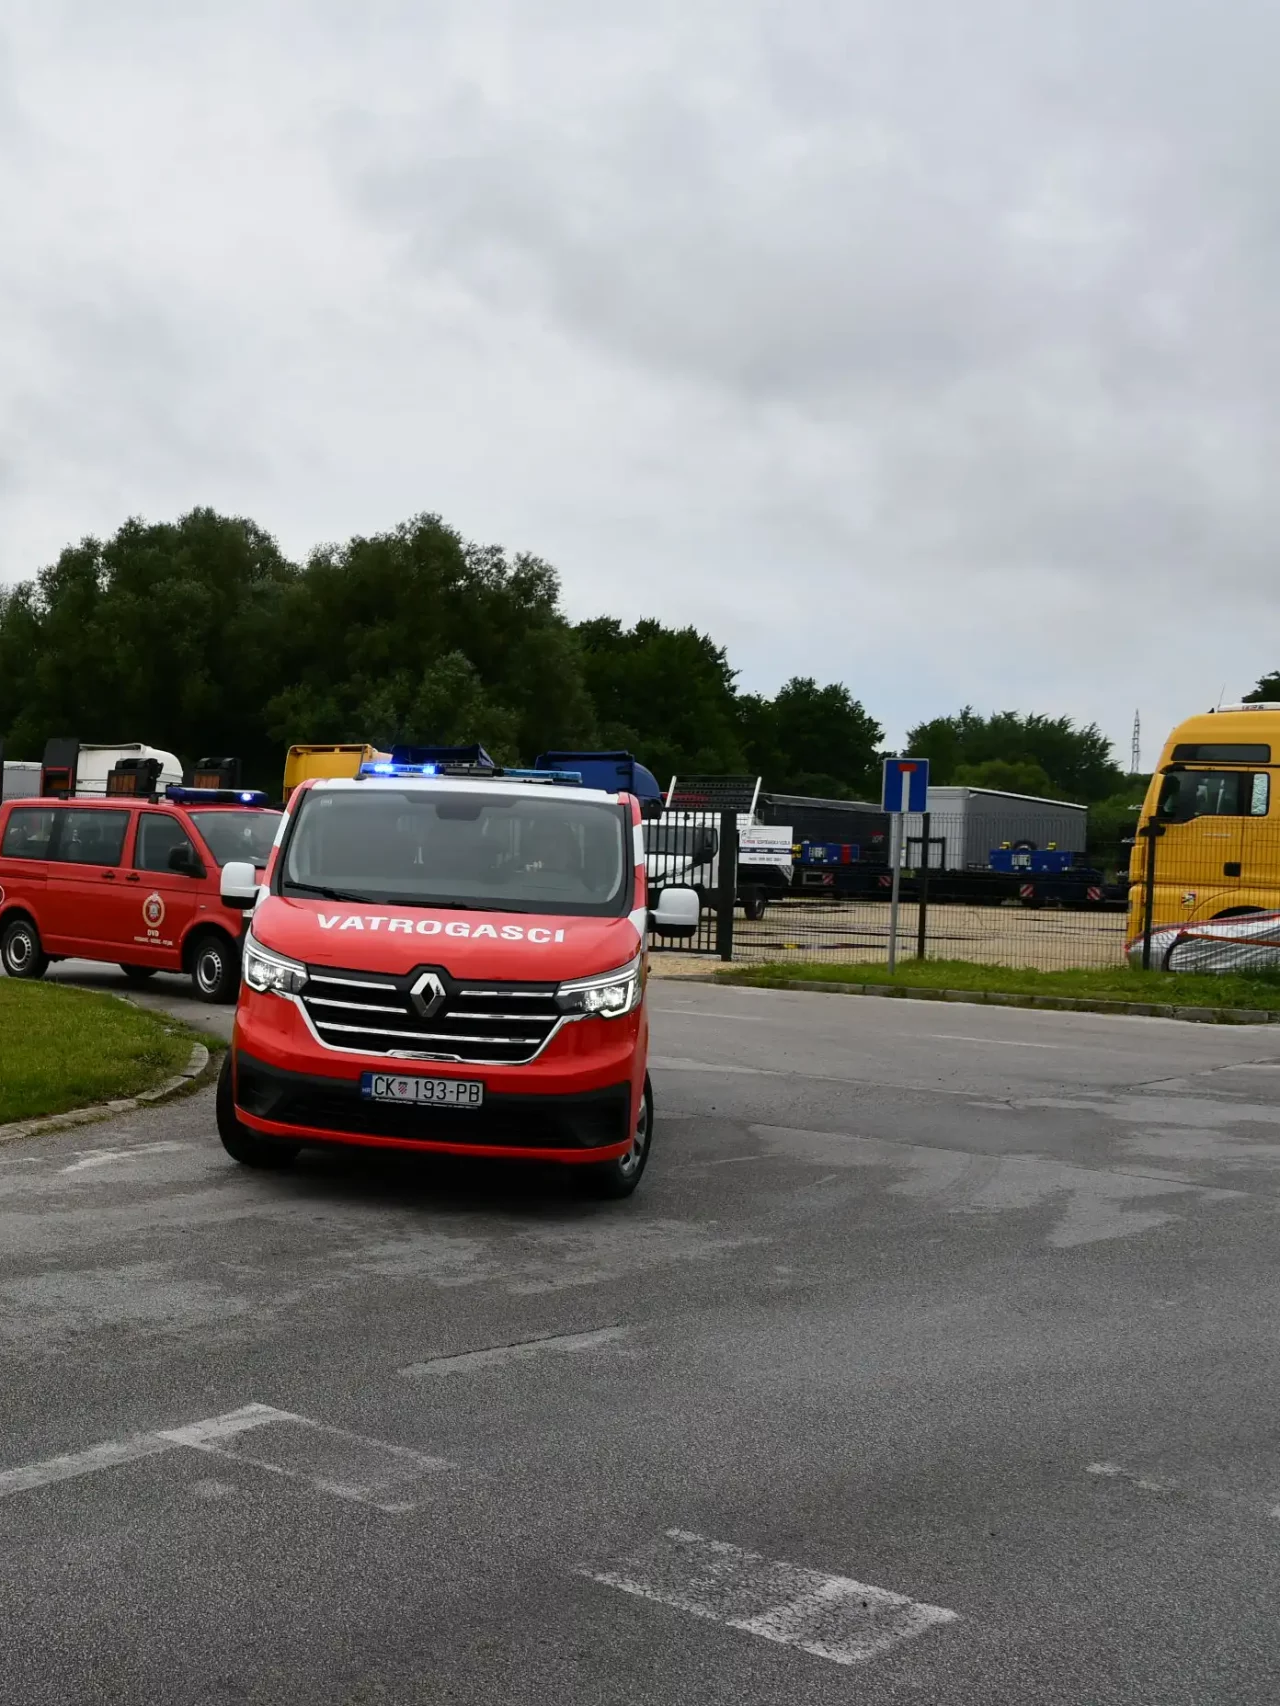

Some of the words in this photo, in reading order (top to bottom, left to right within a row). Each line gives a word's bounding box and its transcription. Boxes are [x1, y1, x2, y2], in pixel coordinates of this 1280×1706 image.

[317, 914, 564, 943] VATROGASCI
[374, 1076, 396, 1096] CK
[414, 1080, 480, 1103] 193-PB
